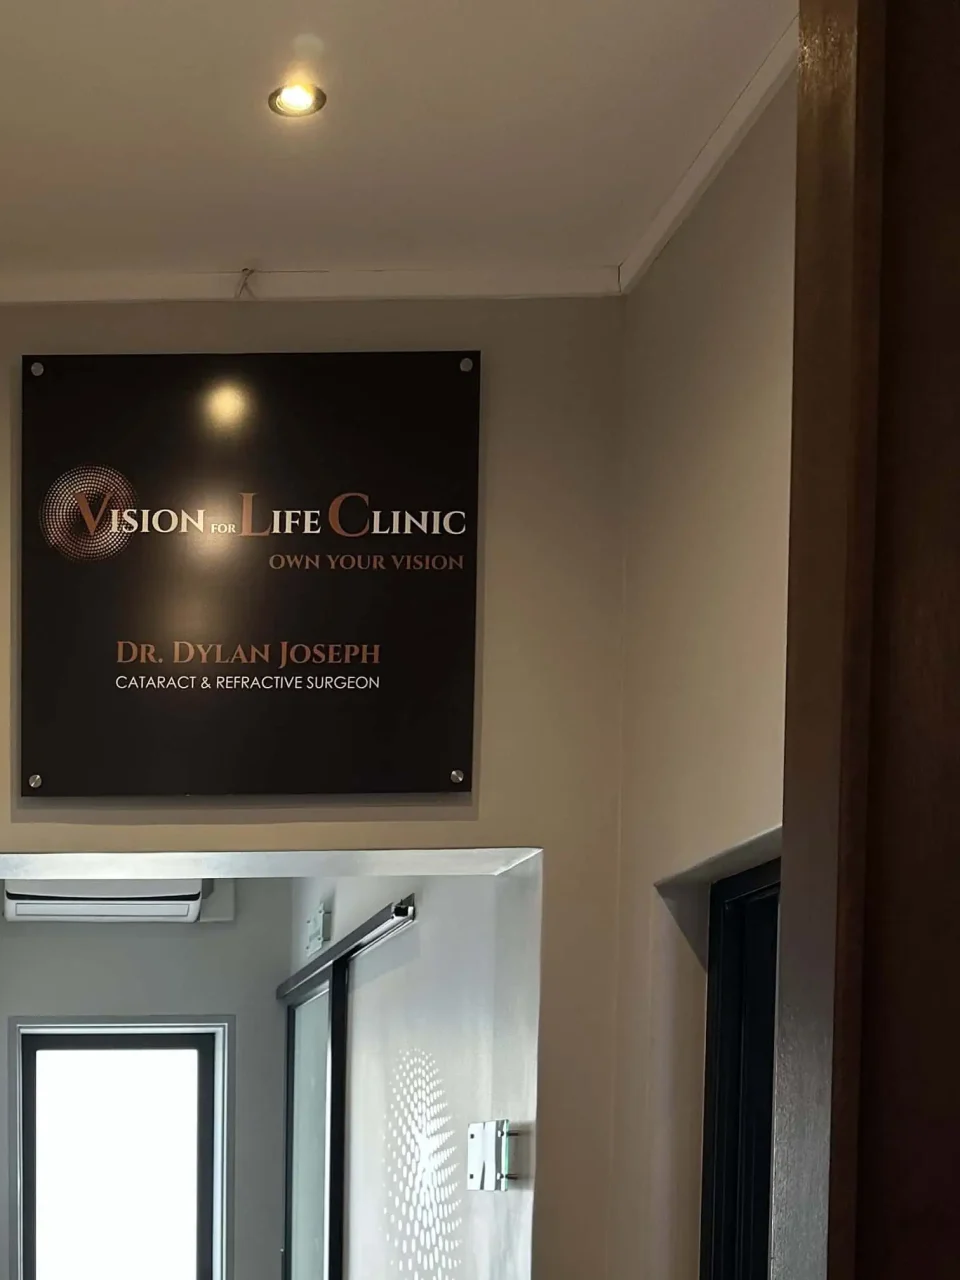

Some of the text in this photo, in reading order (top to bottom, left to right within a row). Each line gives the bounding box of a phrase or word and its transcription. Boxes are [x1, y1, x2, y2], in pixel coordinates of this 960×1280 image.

[269, 554, 464, 570] OWN YOUR VISION
[115, 675, 380, 689] CATARACT & REFRACTIVE SURGEON
